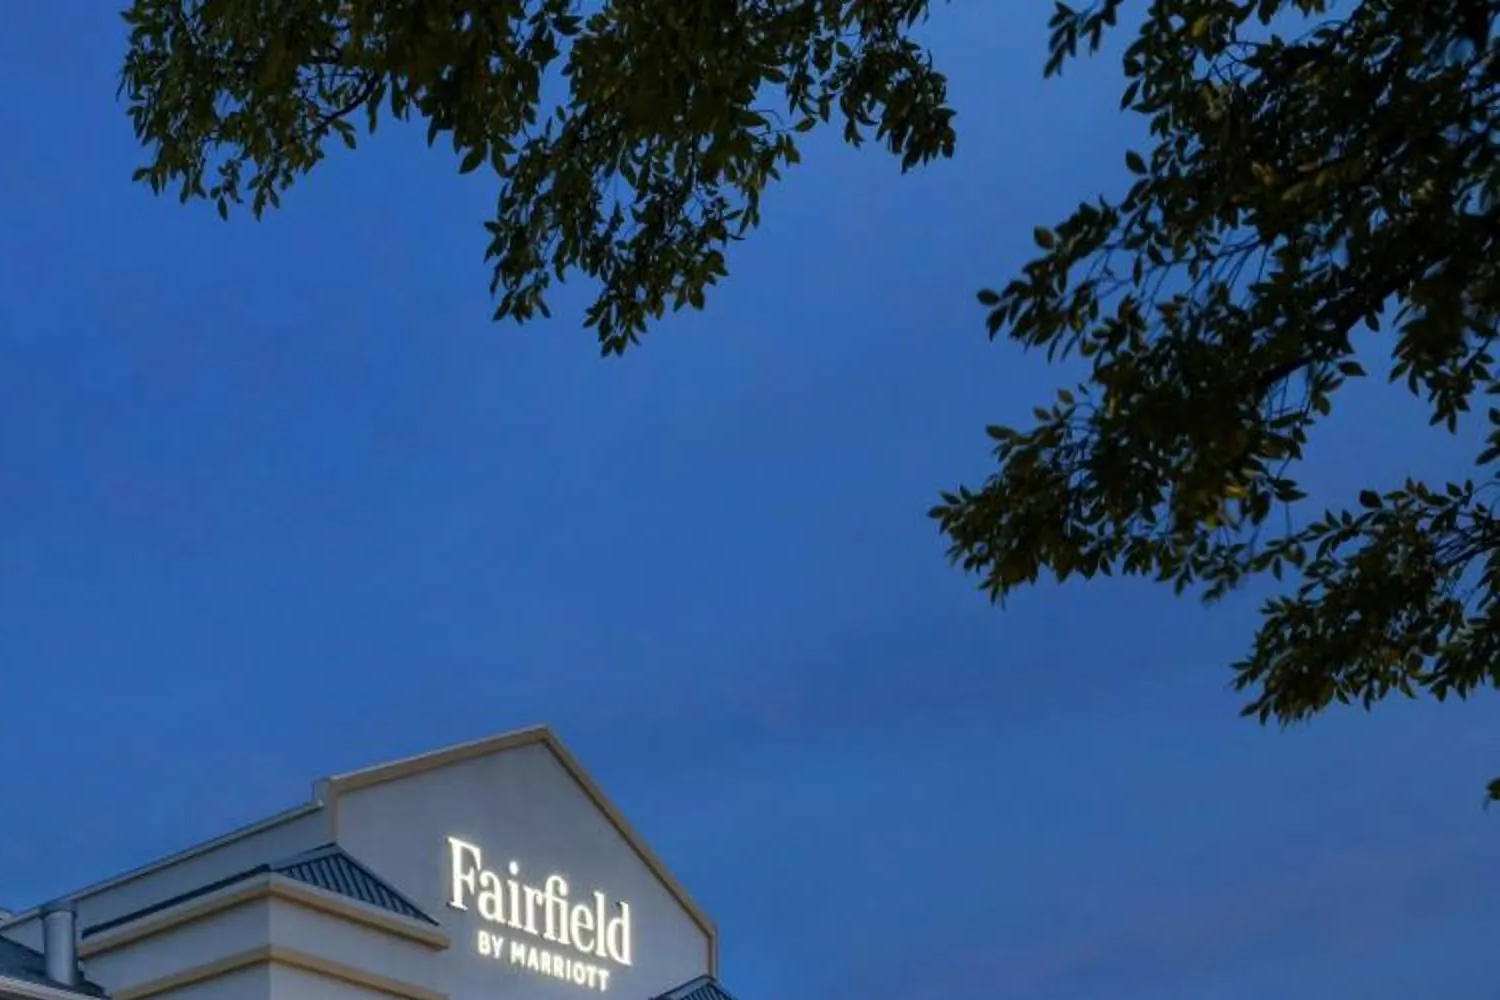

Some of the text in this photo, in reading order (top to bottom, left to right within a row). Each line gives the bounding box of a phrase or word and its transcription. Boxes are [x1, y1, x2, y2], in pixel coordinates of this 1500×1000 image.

[447, 836, 632, 966] Fairfield
[478, 930, 610, 992] BY MARRIOTT
